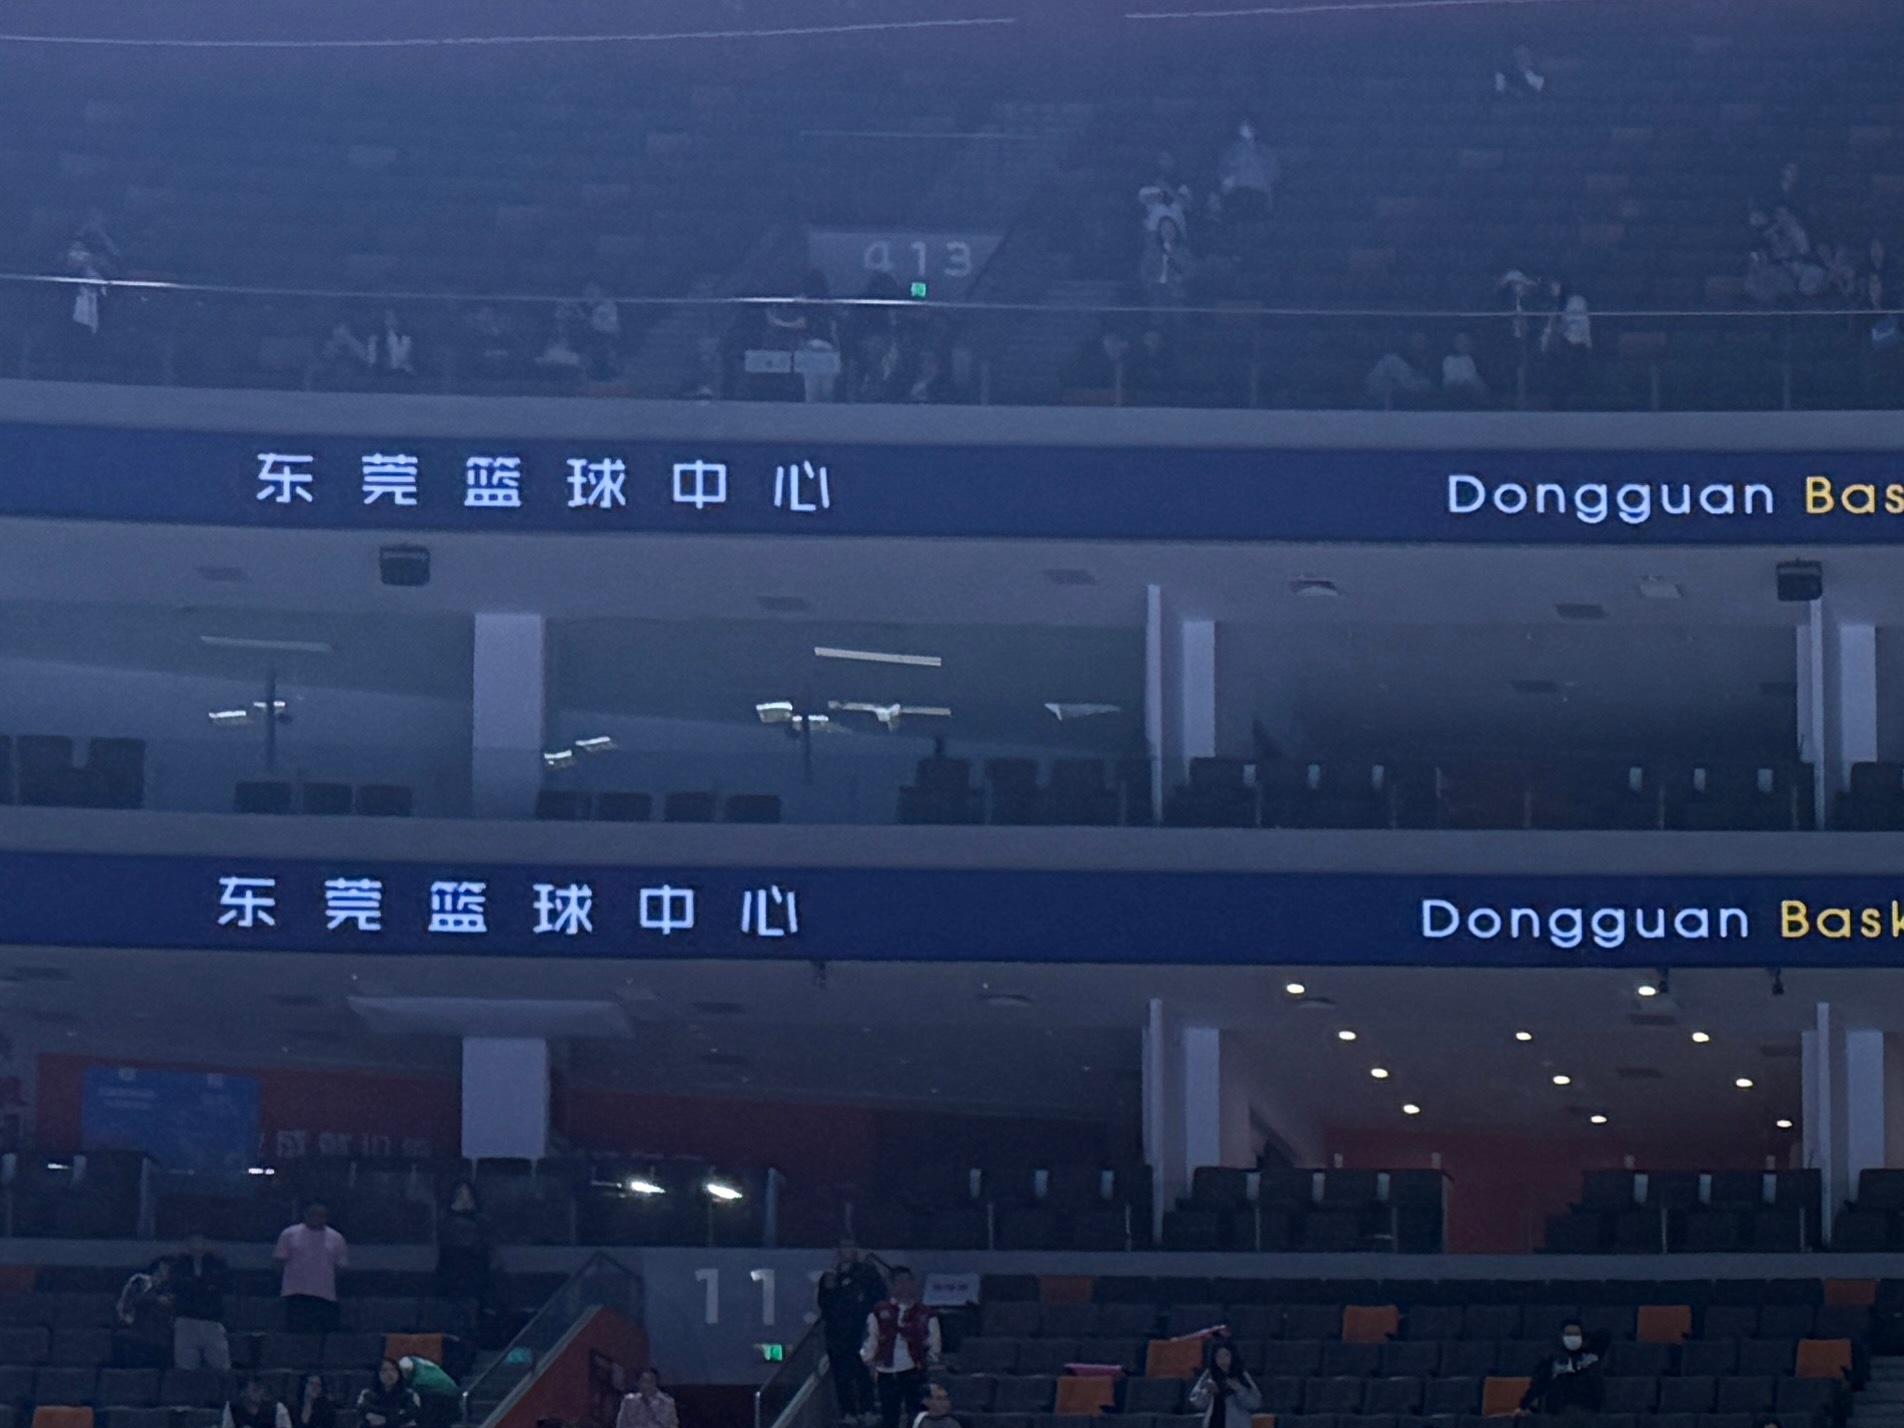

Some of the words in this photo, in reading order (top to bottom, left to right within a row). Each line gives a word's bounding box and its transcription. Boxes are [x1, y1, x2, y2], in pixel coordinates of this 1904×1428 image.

[254, 451, 831, 513] 东莞篮球中心
[1446, 474, 1775, 526] Dongguan
[216, 876, 799, 937] 东莞篮球中心
[1421, 898, 1750, 950] Dongguan
[696, 1267, 822, 1325] 11
